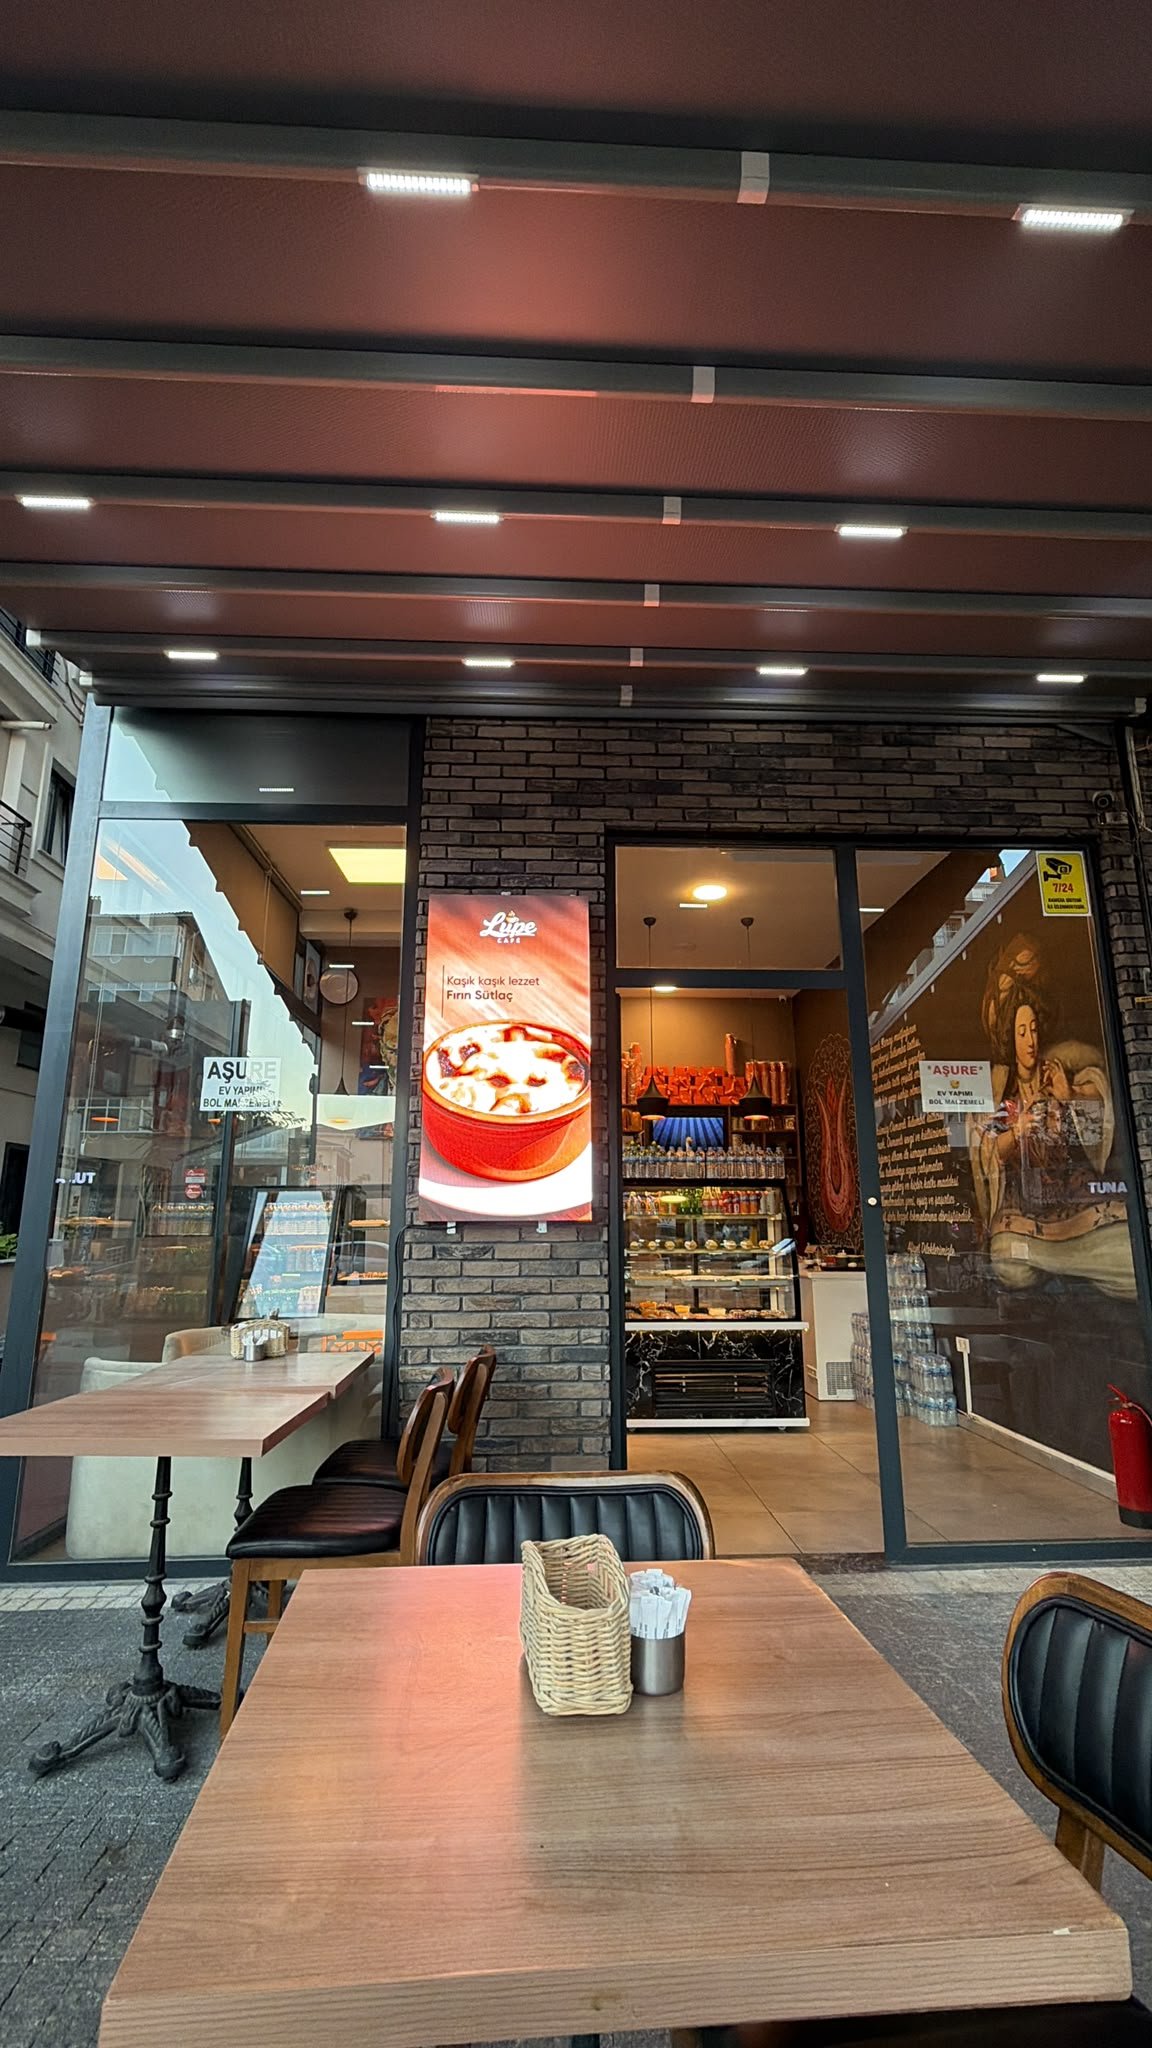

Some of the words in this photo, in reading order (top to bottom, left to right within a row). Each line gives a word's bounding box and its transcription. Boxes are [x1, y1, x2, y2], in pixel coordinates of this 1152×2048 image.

[1052, 883, 1074, 893] 7/24
[480, 911, 537, 938] Lupe
[447, 975, 475, 988] Kaşık
[479, 975, 506, 988] kaşık
[509, 976, 540, 986] lezzet
[446, 990, 472, 1000] Fırın
[475, 989, 513, 1003] Sütlaç
[207, 1061, 277, 1084] AŞURE
[933, 1065, 978, 1077] AŞURE
[218, 1086, 231, 1095] EV
[203, 1098, 222, 1107] BOL
[1088, 1181, 1128, 1194] TUNA
